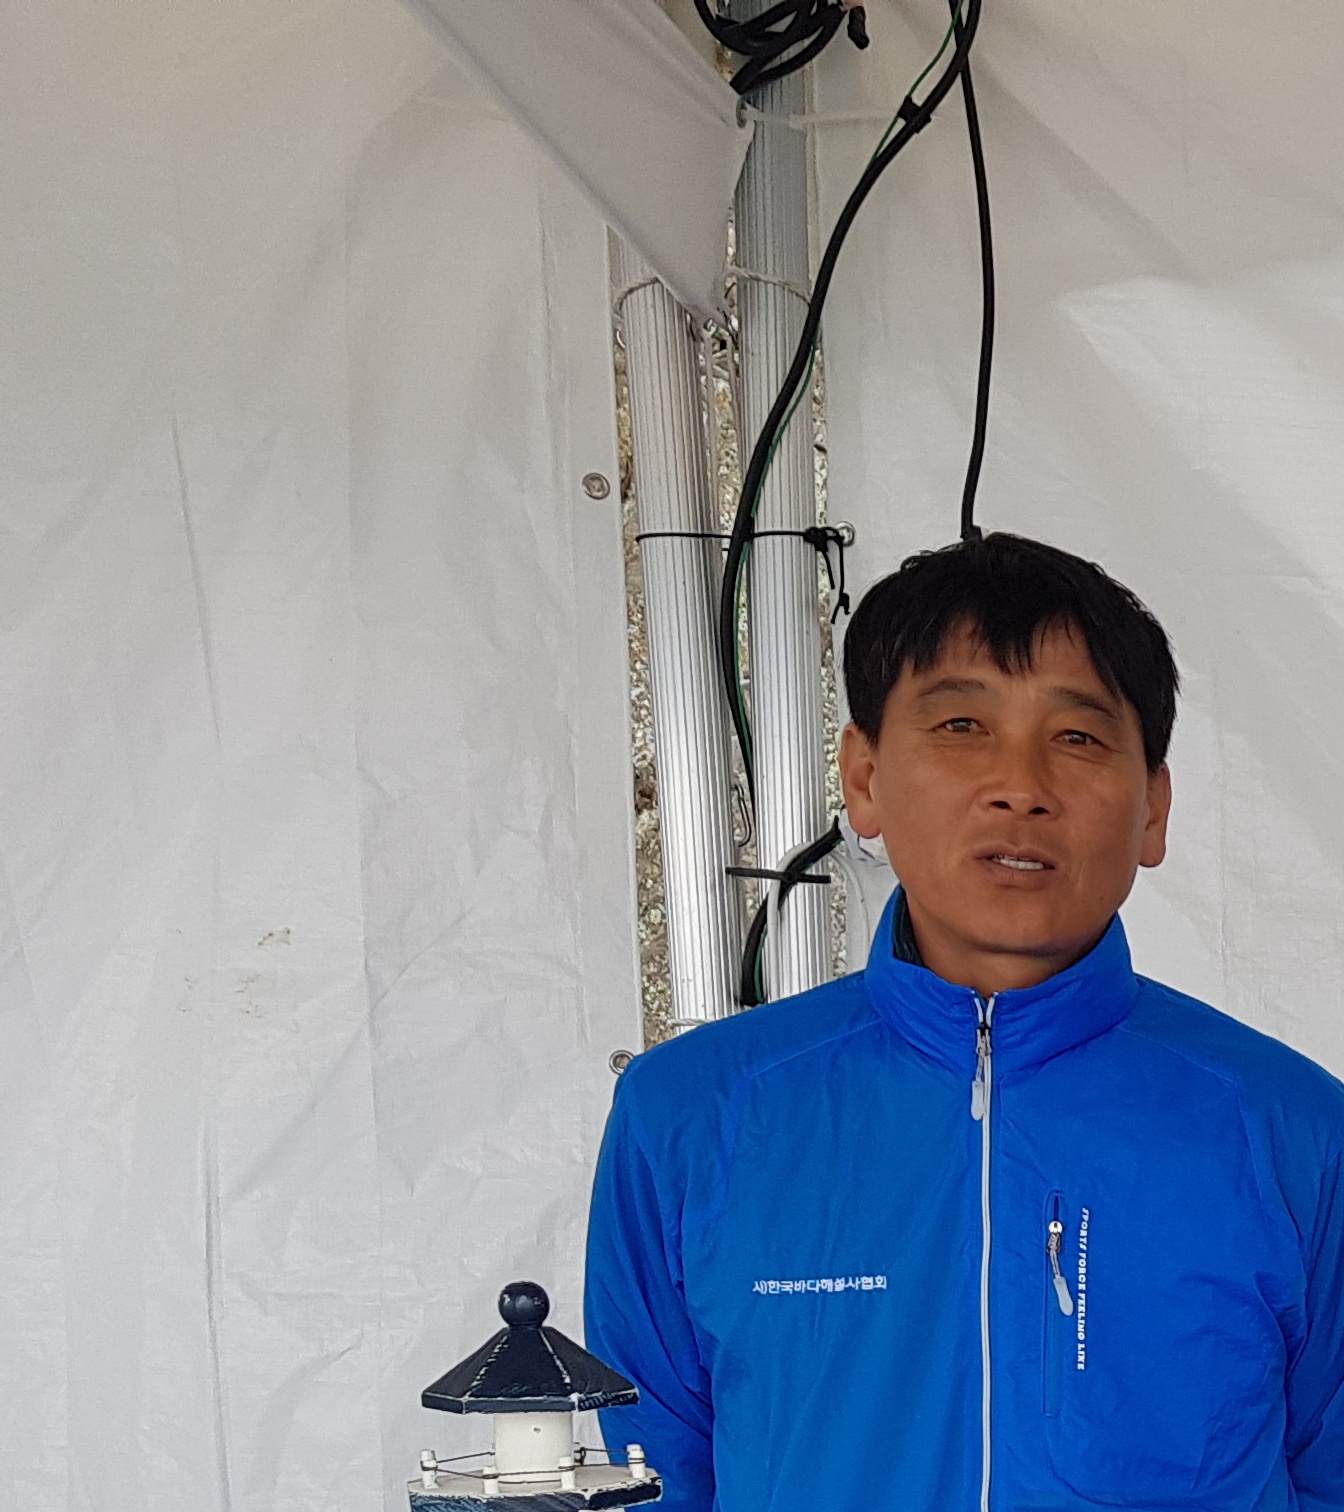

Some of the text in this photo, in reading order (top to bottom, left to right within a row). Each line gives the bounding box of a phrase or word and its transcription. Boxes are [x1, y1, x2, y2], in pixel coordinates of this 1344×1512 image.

[1076, 1207, 1090, 1371] SPORTS FORCE FEELING LIKE
